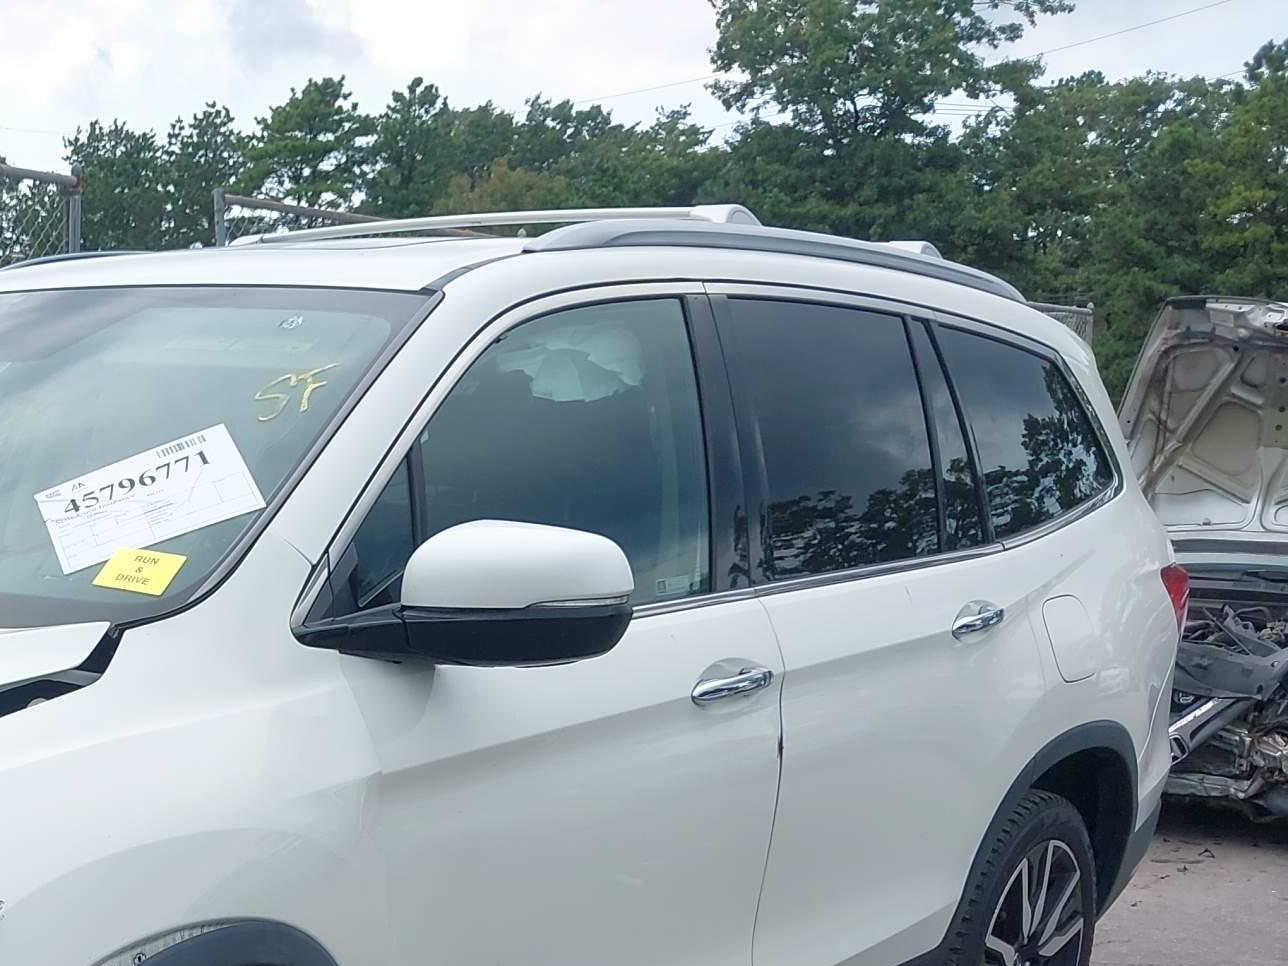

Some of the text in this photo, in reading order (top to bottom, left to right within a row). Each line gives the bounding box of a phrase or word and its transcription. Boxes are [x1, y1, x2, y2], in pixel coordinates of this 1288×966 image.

[64, 450, 210, 513] 45796771
[134, 555, 160, 565] RUN
[115, 573, 151, 586] DRIVE
